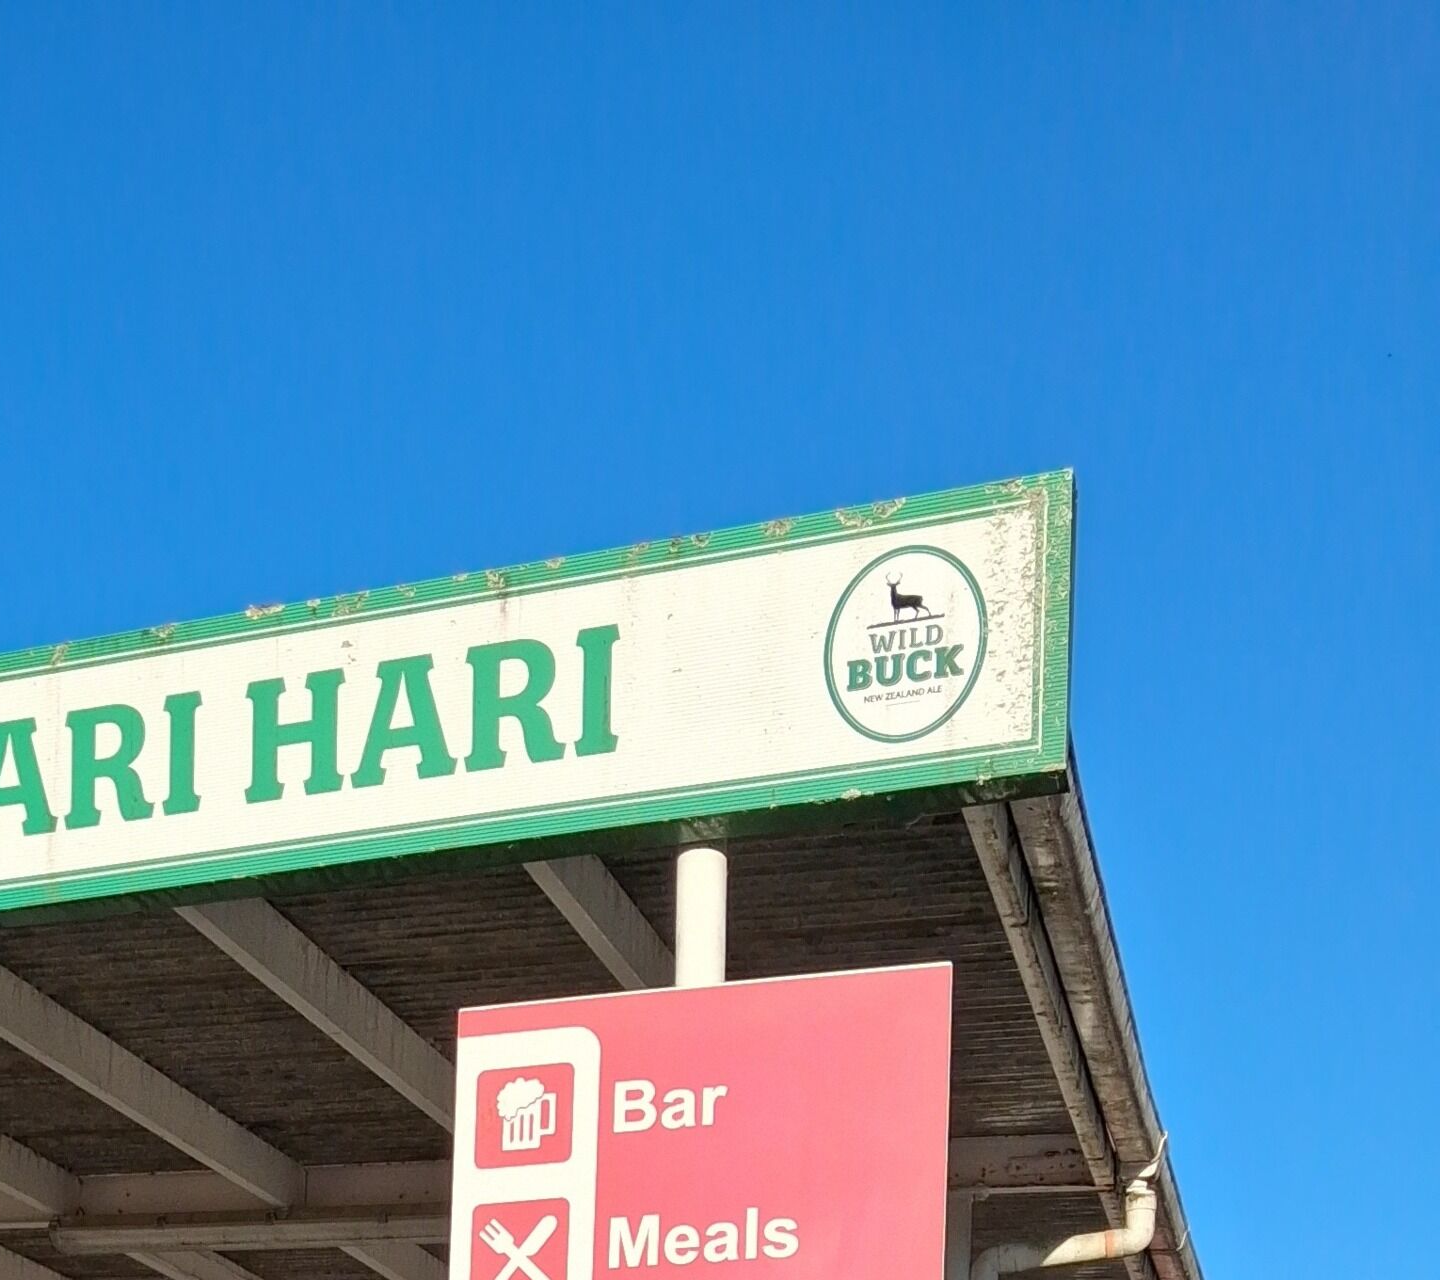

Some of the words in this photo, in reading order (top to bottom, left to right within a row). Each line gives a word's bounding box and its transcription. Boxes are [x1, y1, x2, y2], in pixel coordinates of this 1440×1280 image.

[868, 623, 944, 654] WILD
[846, 644, 964, 691] BUCK
[244, 623, 621, 805] HARI
[864, 694, 883, 703] NEW
[886, 688, 925, 700] ZEALAND
[927, 686, 942, 694] ALE
[612, 1078, 728, 1134] Bar
[607, 1206, 800, 1270] Meals
